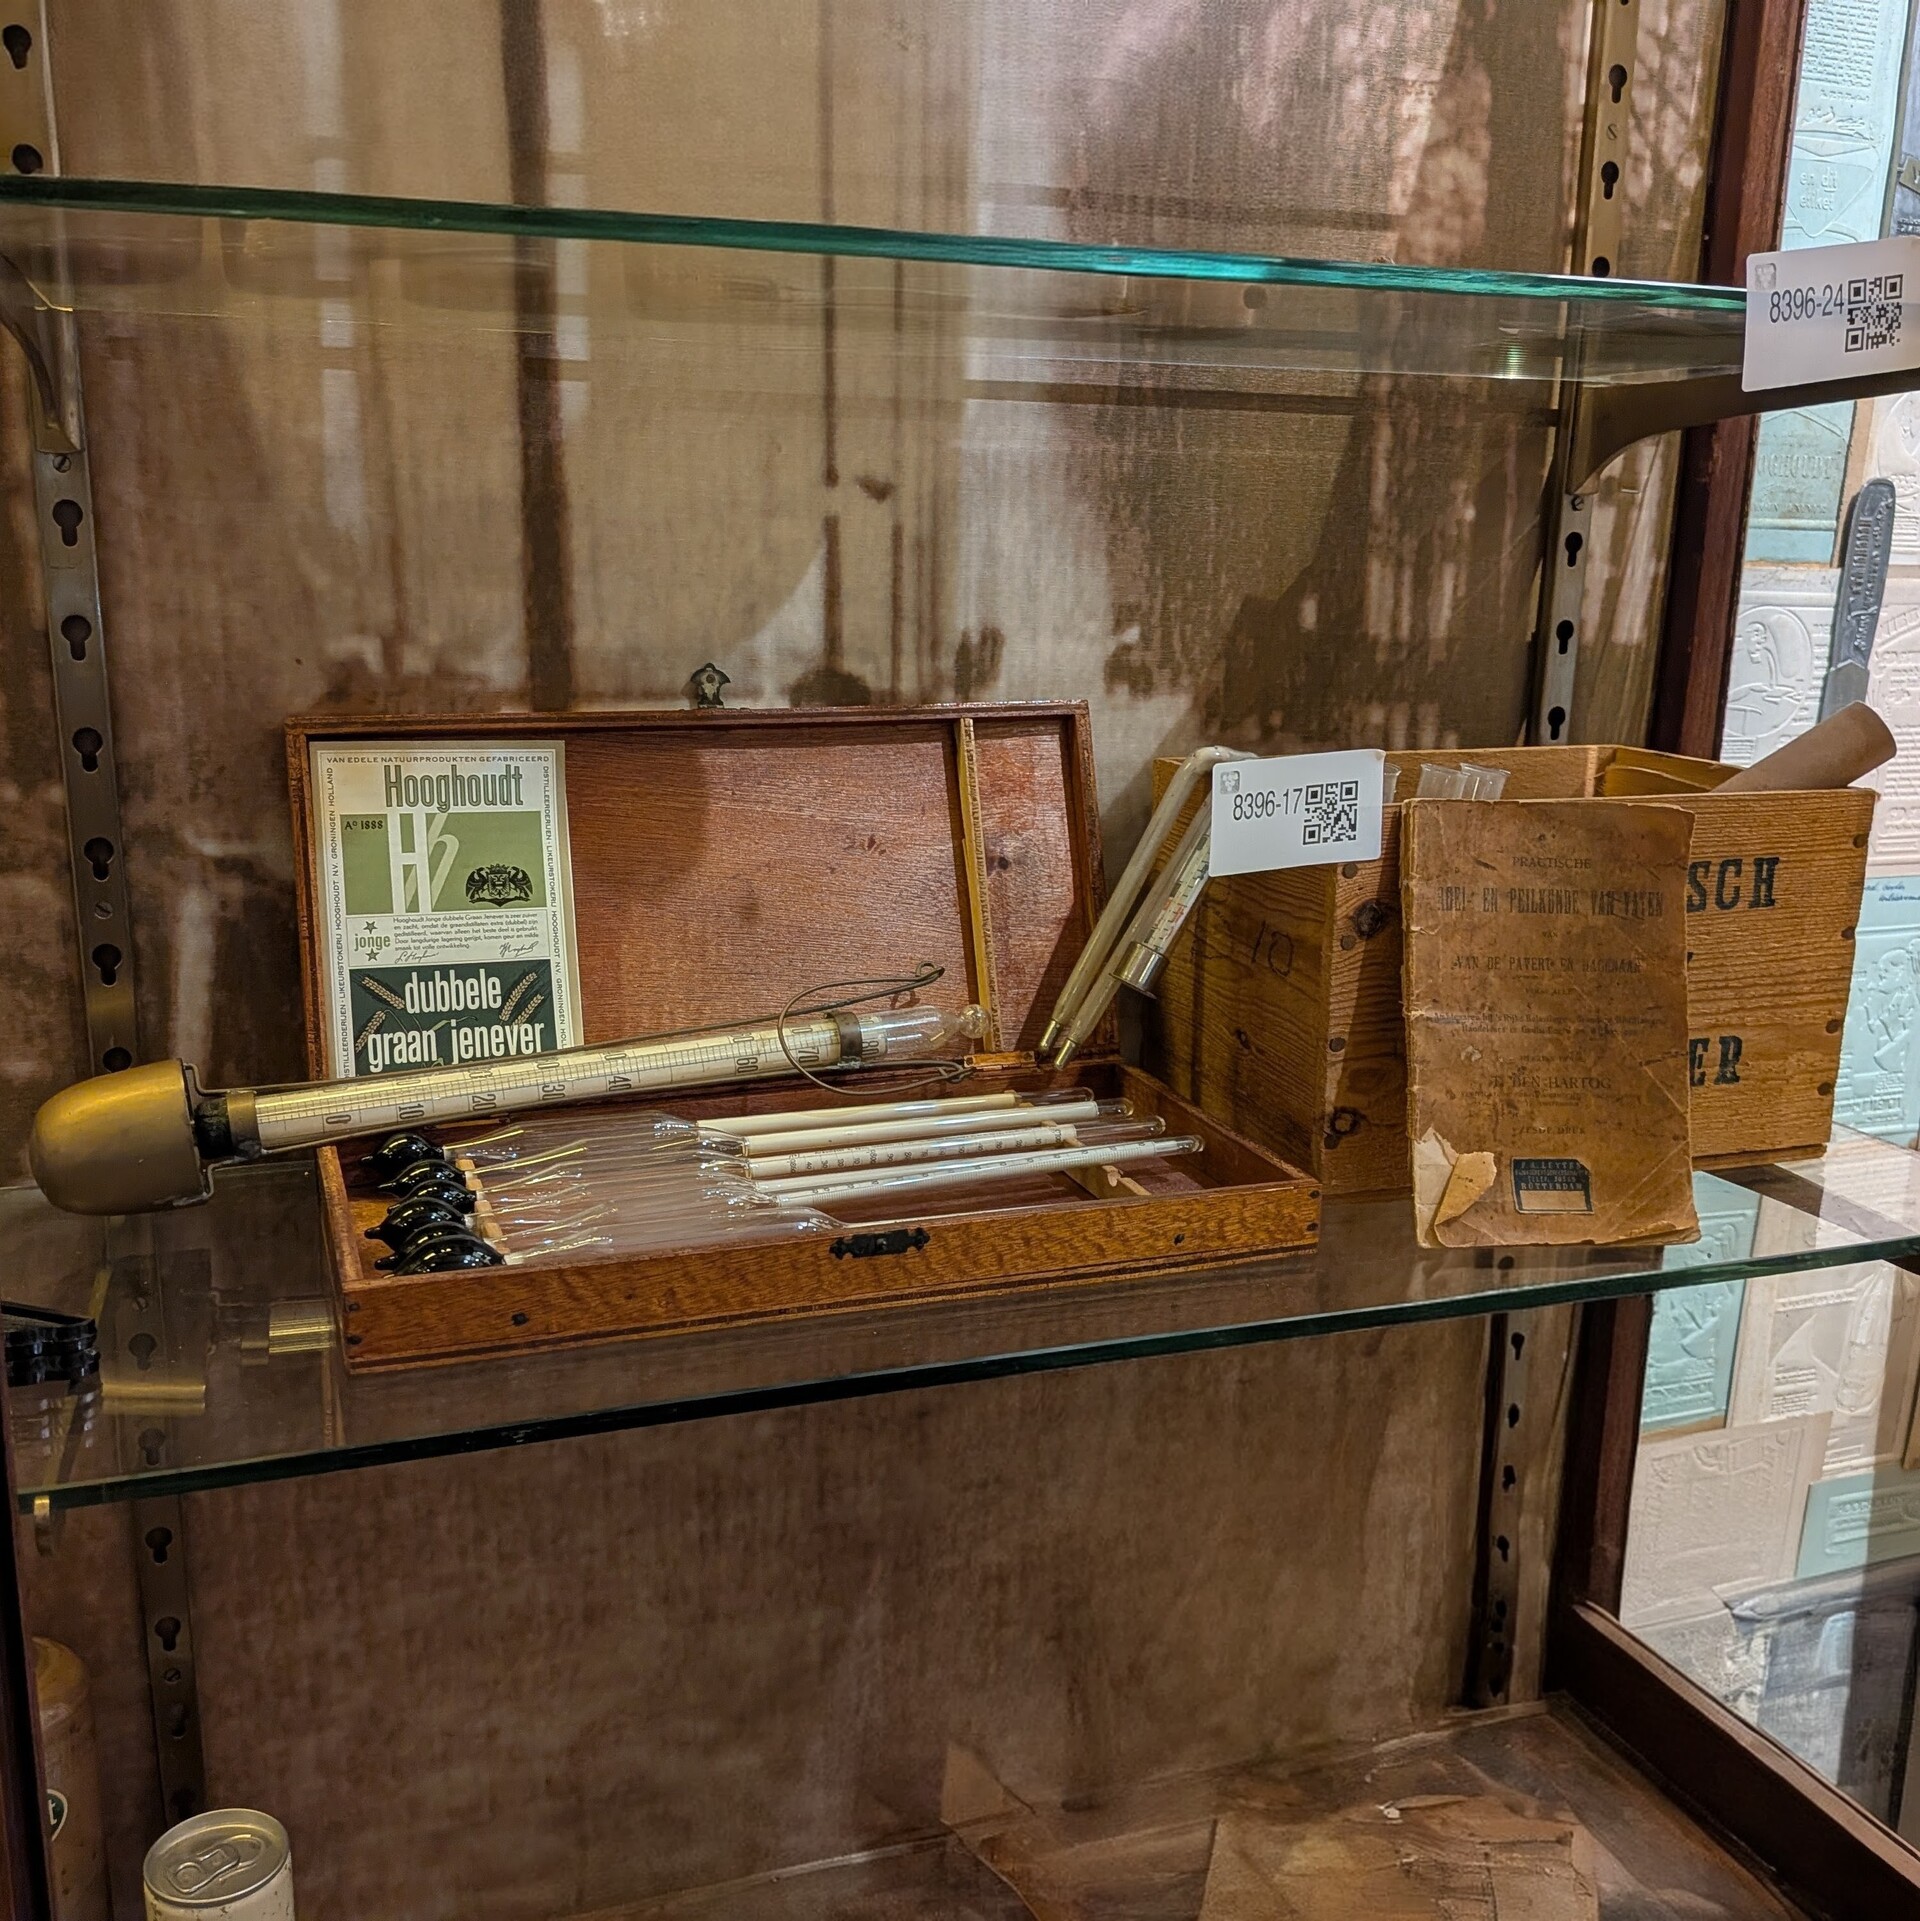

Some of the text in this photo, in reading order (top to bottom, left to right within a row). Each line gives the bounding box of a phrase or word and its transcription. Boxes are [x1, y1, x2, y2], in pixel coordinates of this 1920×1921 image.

[1769, 283, 1845, 323] 8396-24
[479, 755, 549, 763] GEFABRICEERD
[383, 764, 524, 813] Hooghoudt
[1233, 787, 1303, 821] 8396-17
[360, 819, 384, 830] 1888
[329, 810, 338, 859] GRONINGEN
[1512, 856, 1592, 869] PRACTISCHE
[1686, 856, 1780, 914] SCH
[333, 880, 342, 930] HOOGHOUDT
[354, 933, 391, 951] jonge
[551, 911, 561, 958] HOOGHOUDT
[557, 978, 566, 1025] GRONINGEN
[405, 968, 502, 1014] dubbele
[339, 1004, 350, 1078] ISTILLEERDERIJEN
[367, 1018, 545, 1073] graan jenever
[798, 1046, 820, 1063] 70
[736, 1056, 759, 1074] 60
[541, 1083, 567, 1101] 30
[608, 1075, 632, 1092] 40
[1548, 1076, 1612, 1089] HARTOG
[399, 1102, 425, 1120] 10
[471, 1093, 497, 1112] 20
